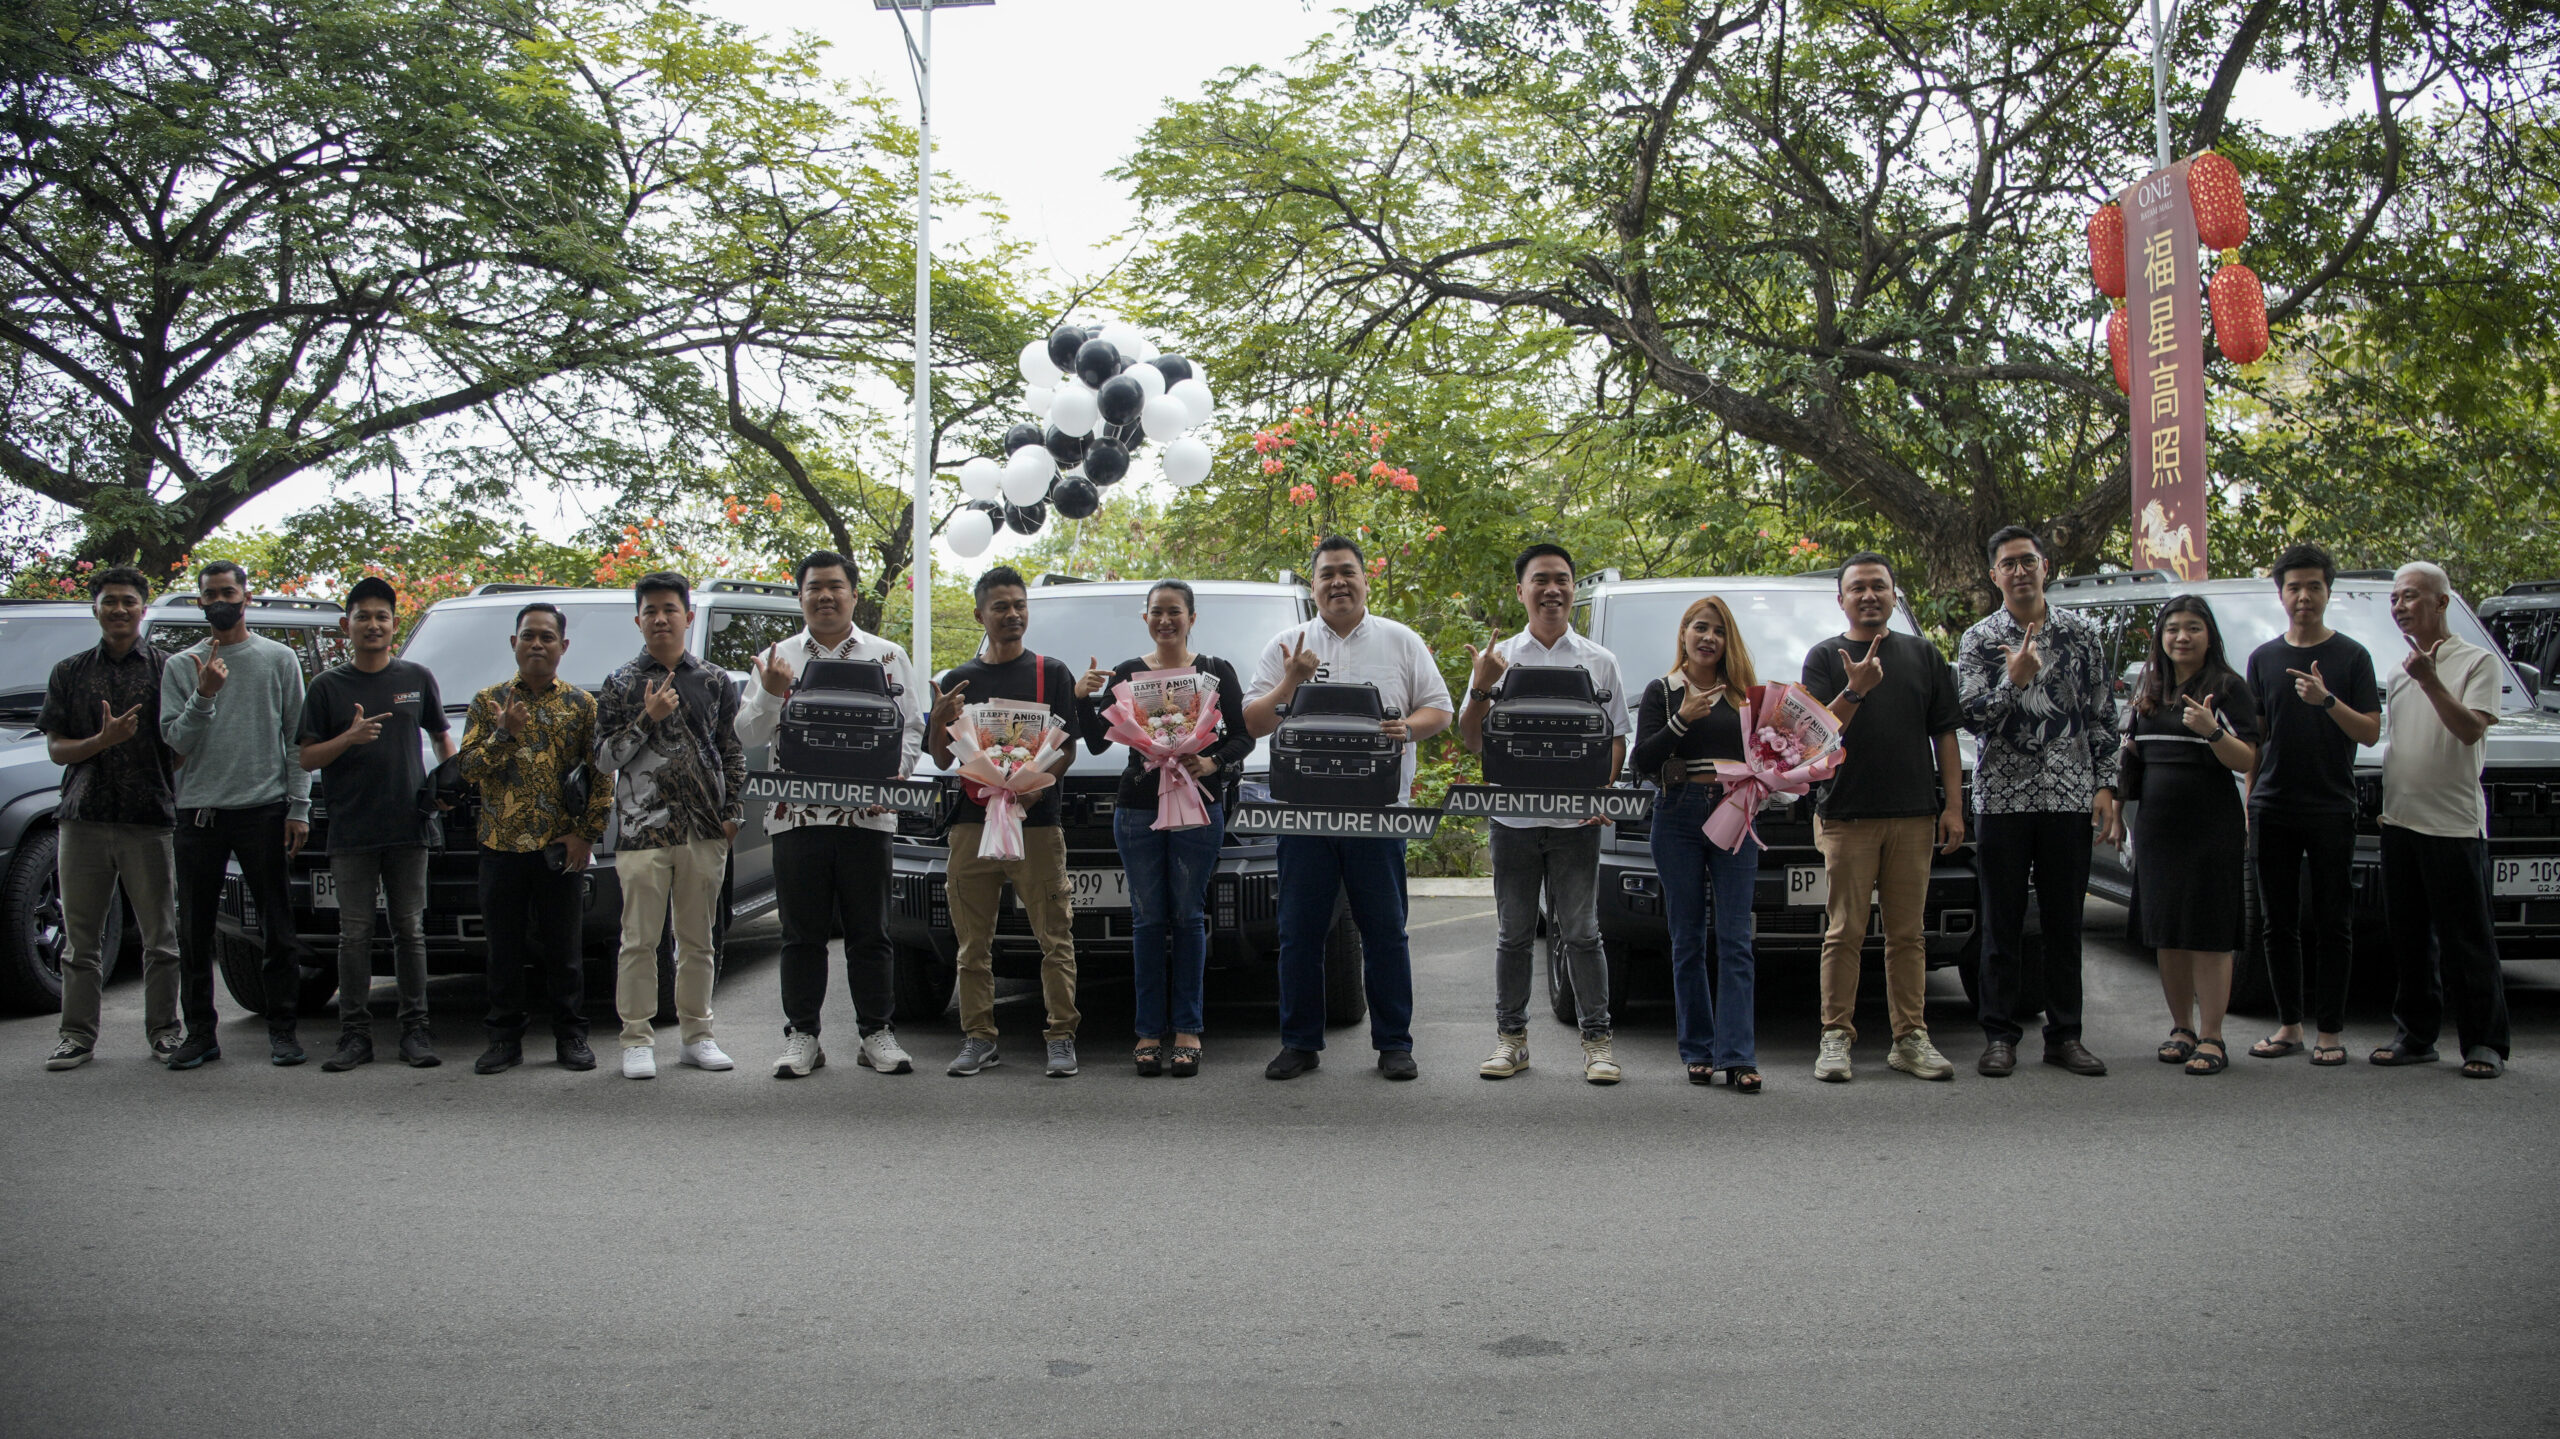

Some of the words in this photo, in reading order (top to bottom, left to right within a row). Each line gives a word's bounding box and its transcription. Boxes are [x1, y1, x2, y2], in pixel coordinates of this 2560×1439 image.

[2138, 174, 2172, 207] ONE
[2143, 228, 2182, 489] 福星高照
[1133, 683, 1162, 692] HAPPY
[746, 778, 874, 804] ADVENTURE
[879, 787, 932, 807] NOW
[1448, 792, 1585, 814] ADVENTURE
[1590, 796, 1646, 816] NOW
[1234, 809, 1373, 832] ADVENTURE
[1378, 814, 1435, 834] NOW
[1067, 873, 1103, 895] 099
[1114, 873, 1125, 894] Y
[1791, 871, 1816, 892] BP
[2496, 862, 2520, 883] BP
[316, 876, 337, 896] BP
